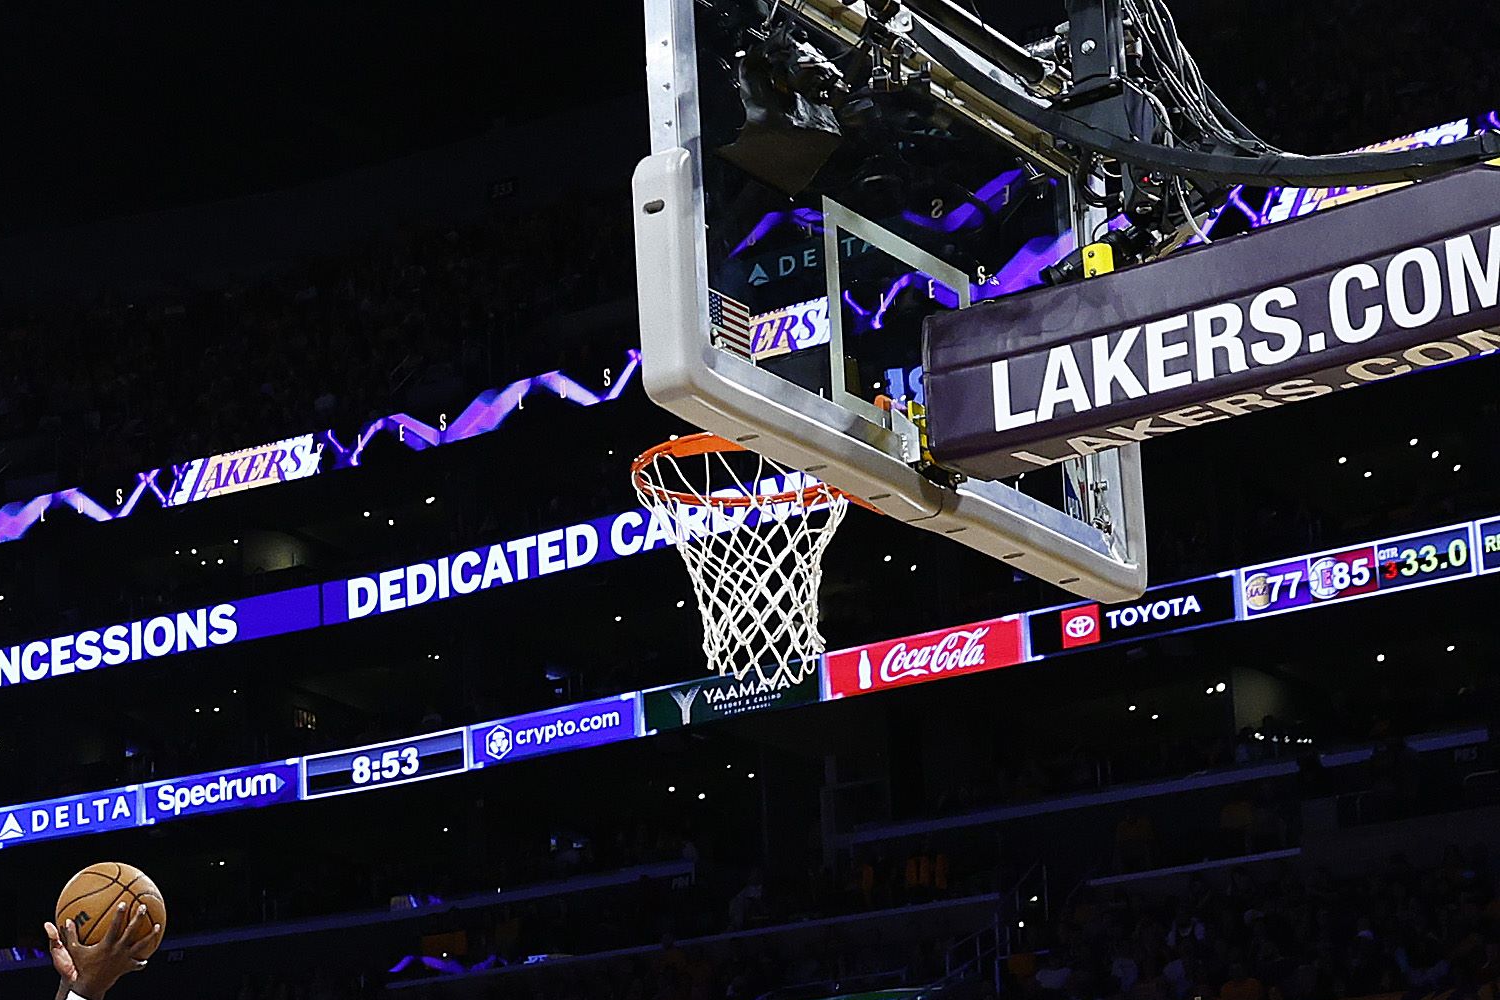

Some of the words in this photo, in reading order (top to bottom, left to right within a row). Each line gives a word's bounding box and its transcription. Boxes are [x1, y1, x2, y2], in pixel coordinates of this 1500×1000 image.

[751, 305, 830, 353] ERS
[991, 225, 1500, 432] LAKERS.COM
[189, 445, 306, 503] LAKERS
[346, 523, 599, 620] DEDICATED
[1384, 560, 1399, 580] 3
[1400, 538, 1468, 577] 33.0
[1266, 571, 1303, 603] 77
[1332, 557, 1371, 590] 85
[1106, 595, 1201, 629] TOYOTA
[880, 626, 990, 682] Coca-Cola
[515, 708, 620, 749] crypto.com
[351, 747, 421, 785] 8:53
[30, 796, 131, 833] DELTA
[157, 772, 278, 815] Spectrum
